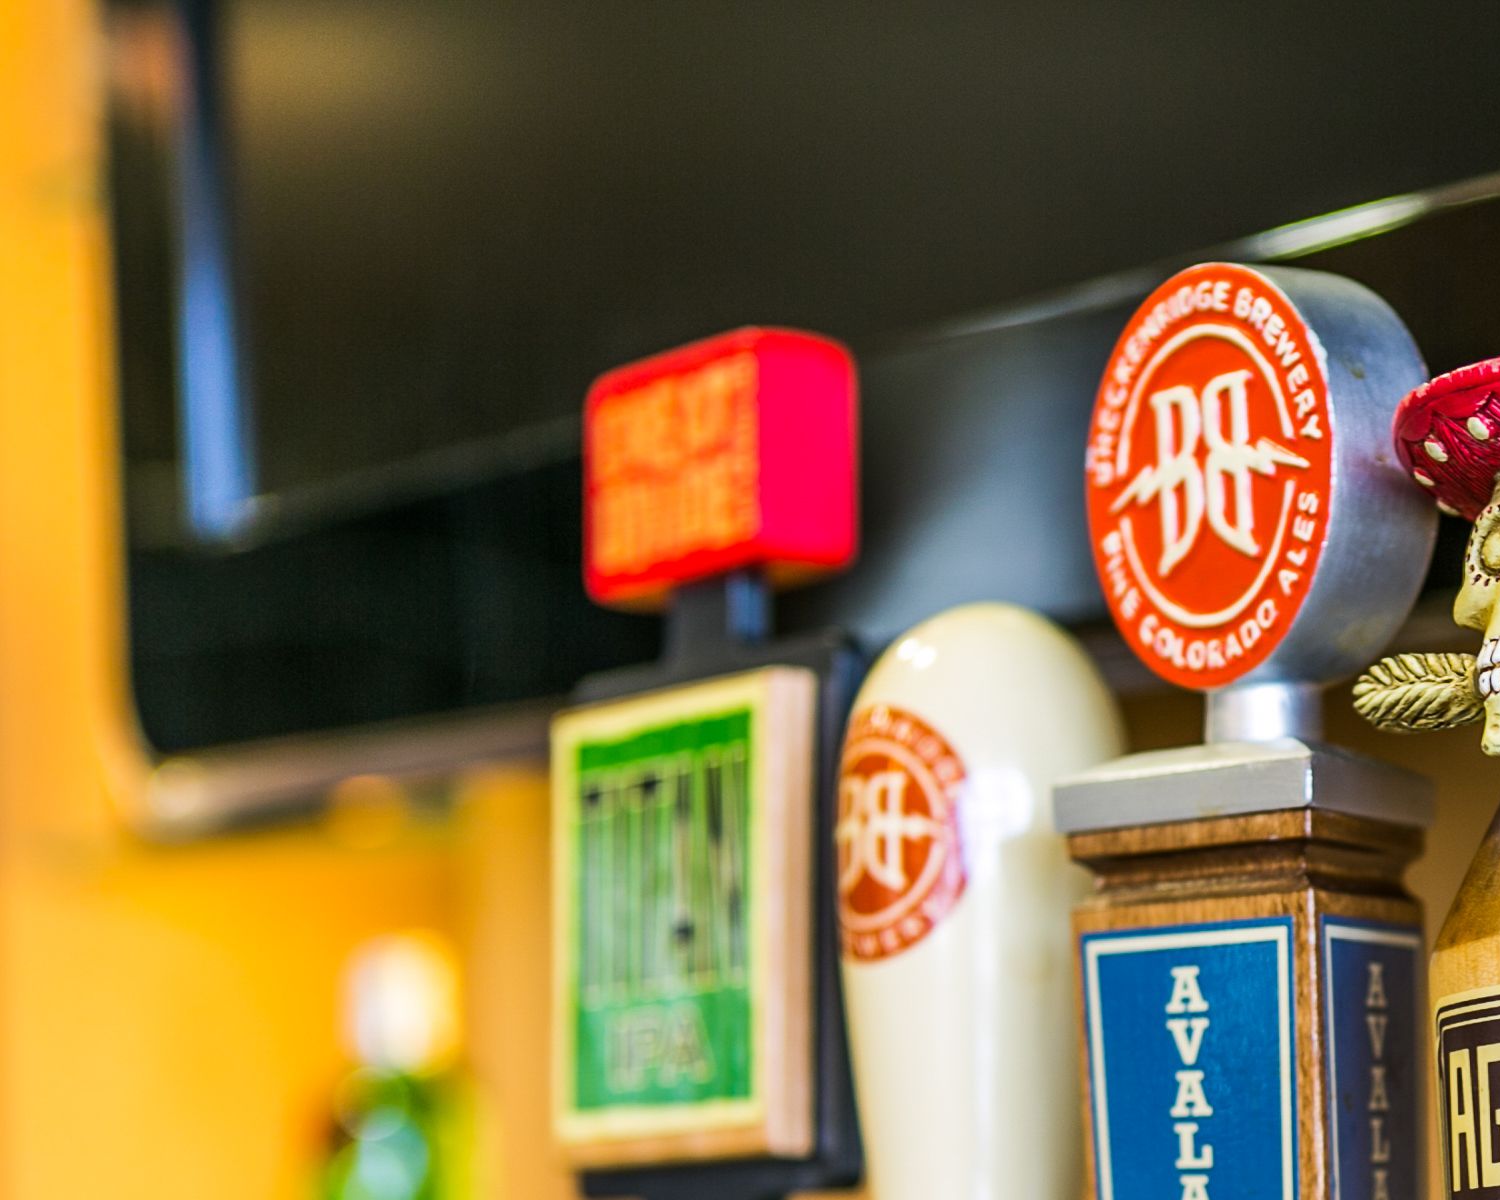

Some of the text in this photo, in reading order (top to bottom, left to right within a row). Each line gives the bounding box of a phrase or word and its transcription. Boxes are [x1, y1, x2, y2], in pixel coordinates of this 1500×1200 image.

[1233, 287, 1323, 440] BREWERY
[1138, 599, 1278, 670] COLORADO
[1278, 491, 1319, 596] ALES
